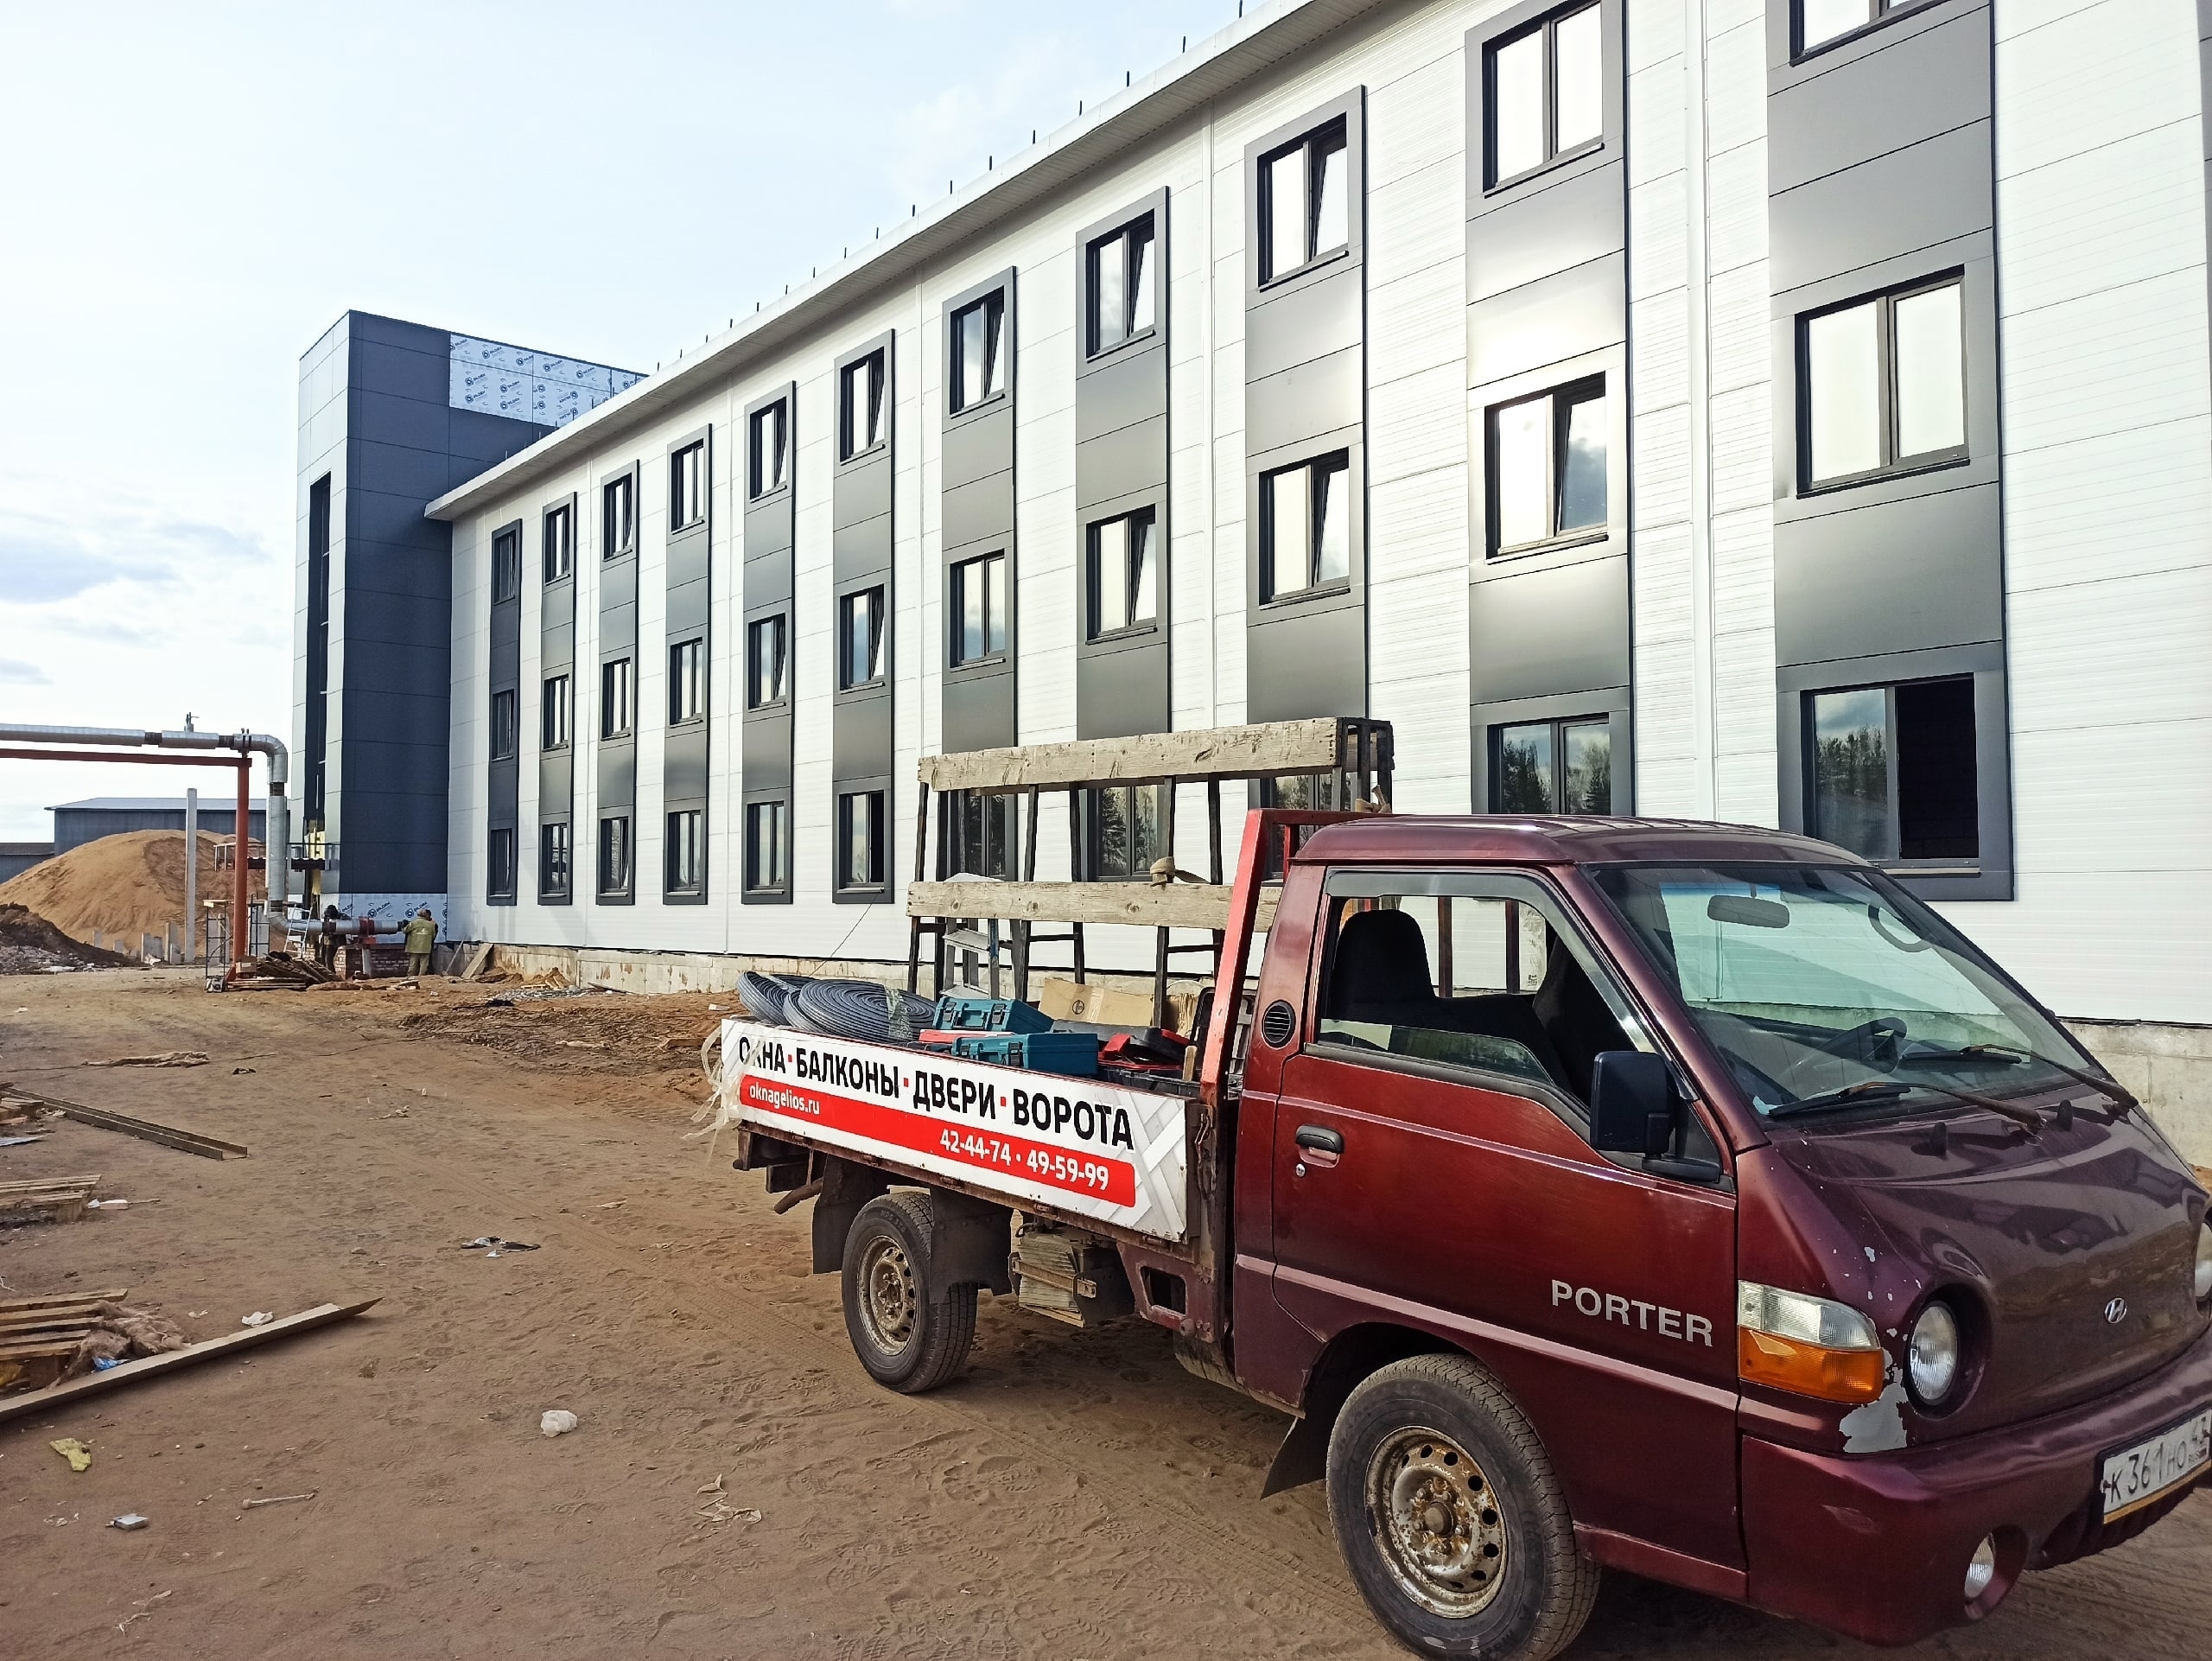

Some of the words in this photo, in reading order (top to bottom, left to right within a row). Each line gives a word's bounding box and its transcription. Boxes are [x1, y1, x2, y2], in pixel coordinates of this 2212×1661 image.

[749, 1081, 821, 1115] oknagelios.ru
[796, 1047, 899, 1098] БАЛКОНЫ
[913, 1070, 996, 1120] ДВЕРИ
[1014, 1088, 1135, 1150] ВОРОТА
[939, 1128, 1012, 1167] 42-44-74
[1026, 1149, 1110, 1191] 49-59-99
[1551, 1279, 1713, 1347] PORTER
